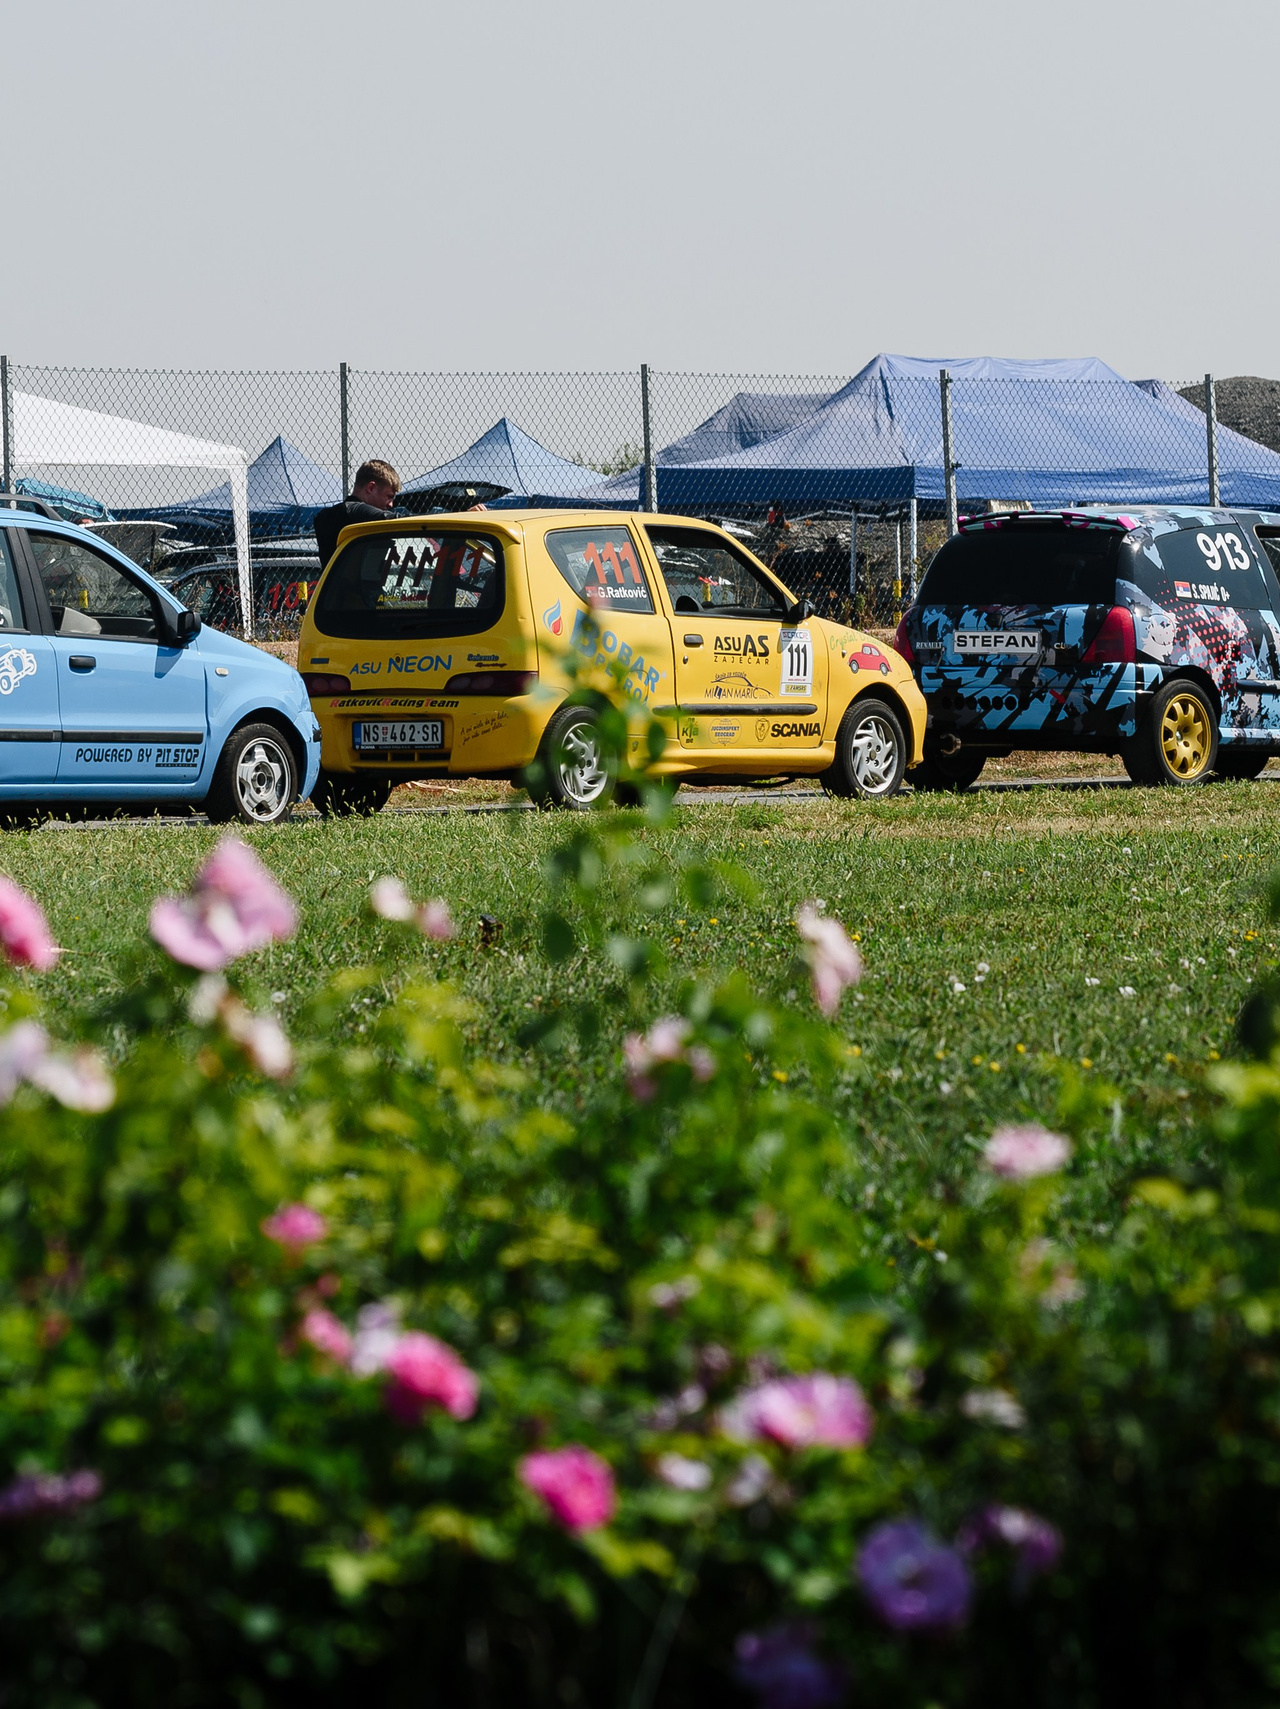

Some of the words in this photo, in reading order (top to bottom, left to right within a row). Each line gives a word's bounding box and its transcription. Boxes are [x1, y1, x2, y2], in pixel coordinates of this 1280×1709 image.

[1196, 532, 1250, 571] 913
[583, 541, 642, 584] 111
[598, 585, 648, 599] G.Ratković
[915, 641, 942, 649] RENAULT
[956, 635, 1036, 648] STEFAN
[349, 662, 381, 676] ASU
[387, 654, 453, 674] NEON
[713, 656, 770, 665] ZAJEČAR
[787, 643, 807, 676] 111
[704, 686, 734, 699] MILAN
[363, 724, 380, 742] NS
[770, 723, 821, 738] SCANIA
[75, 748, 133, 763] POWERED
[137, 748, 153, 763] BY
[155, 748, 172, 763] PIT
[173, 748, 200, 763] STOP
